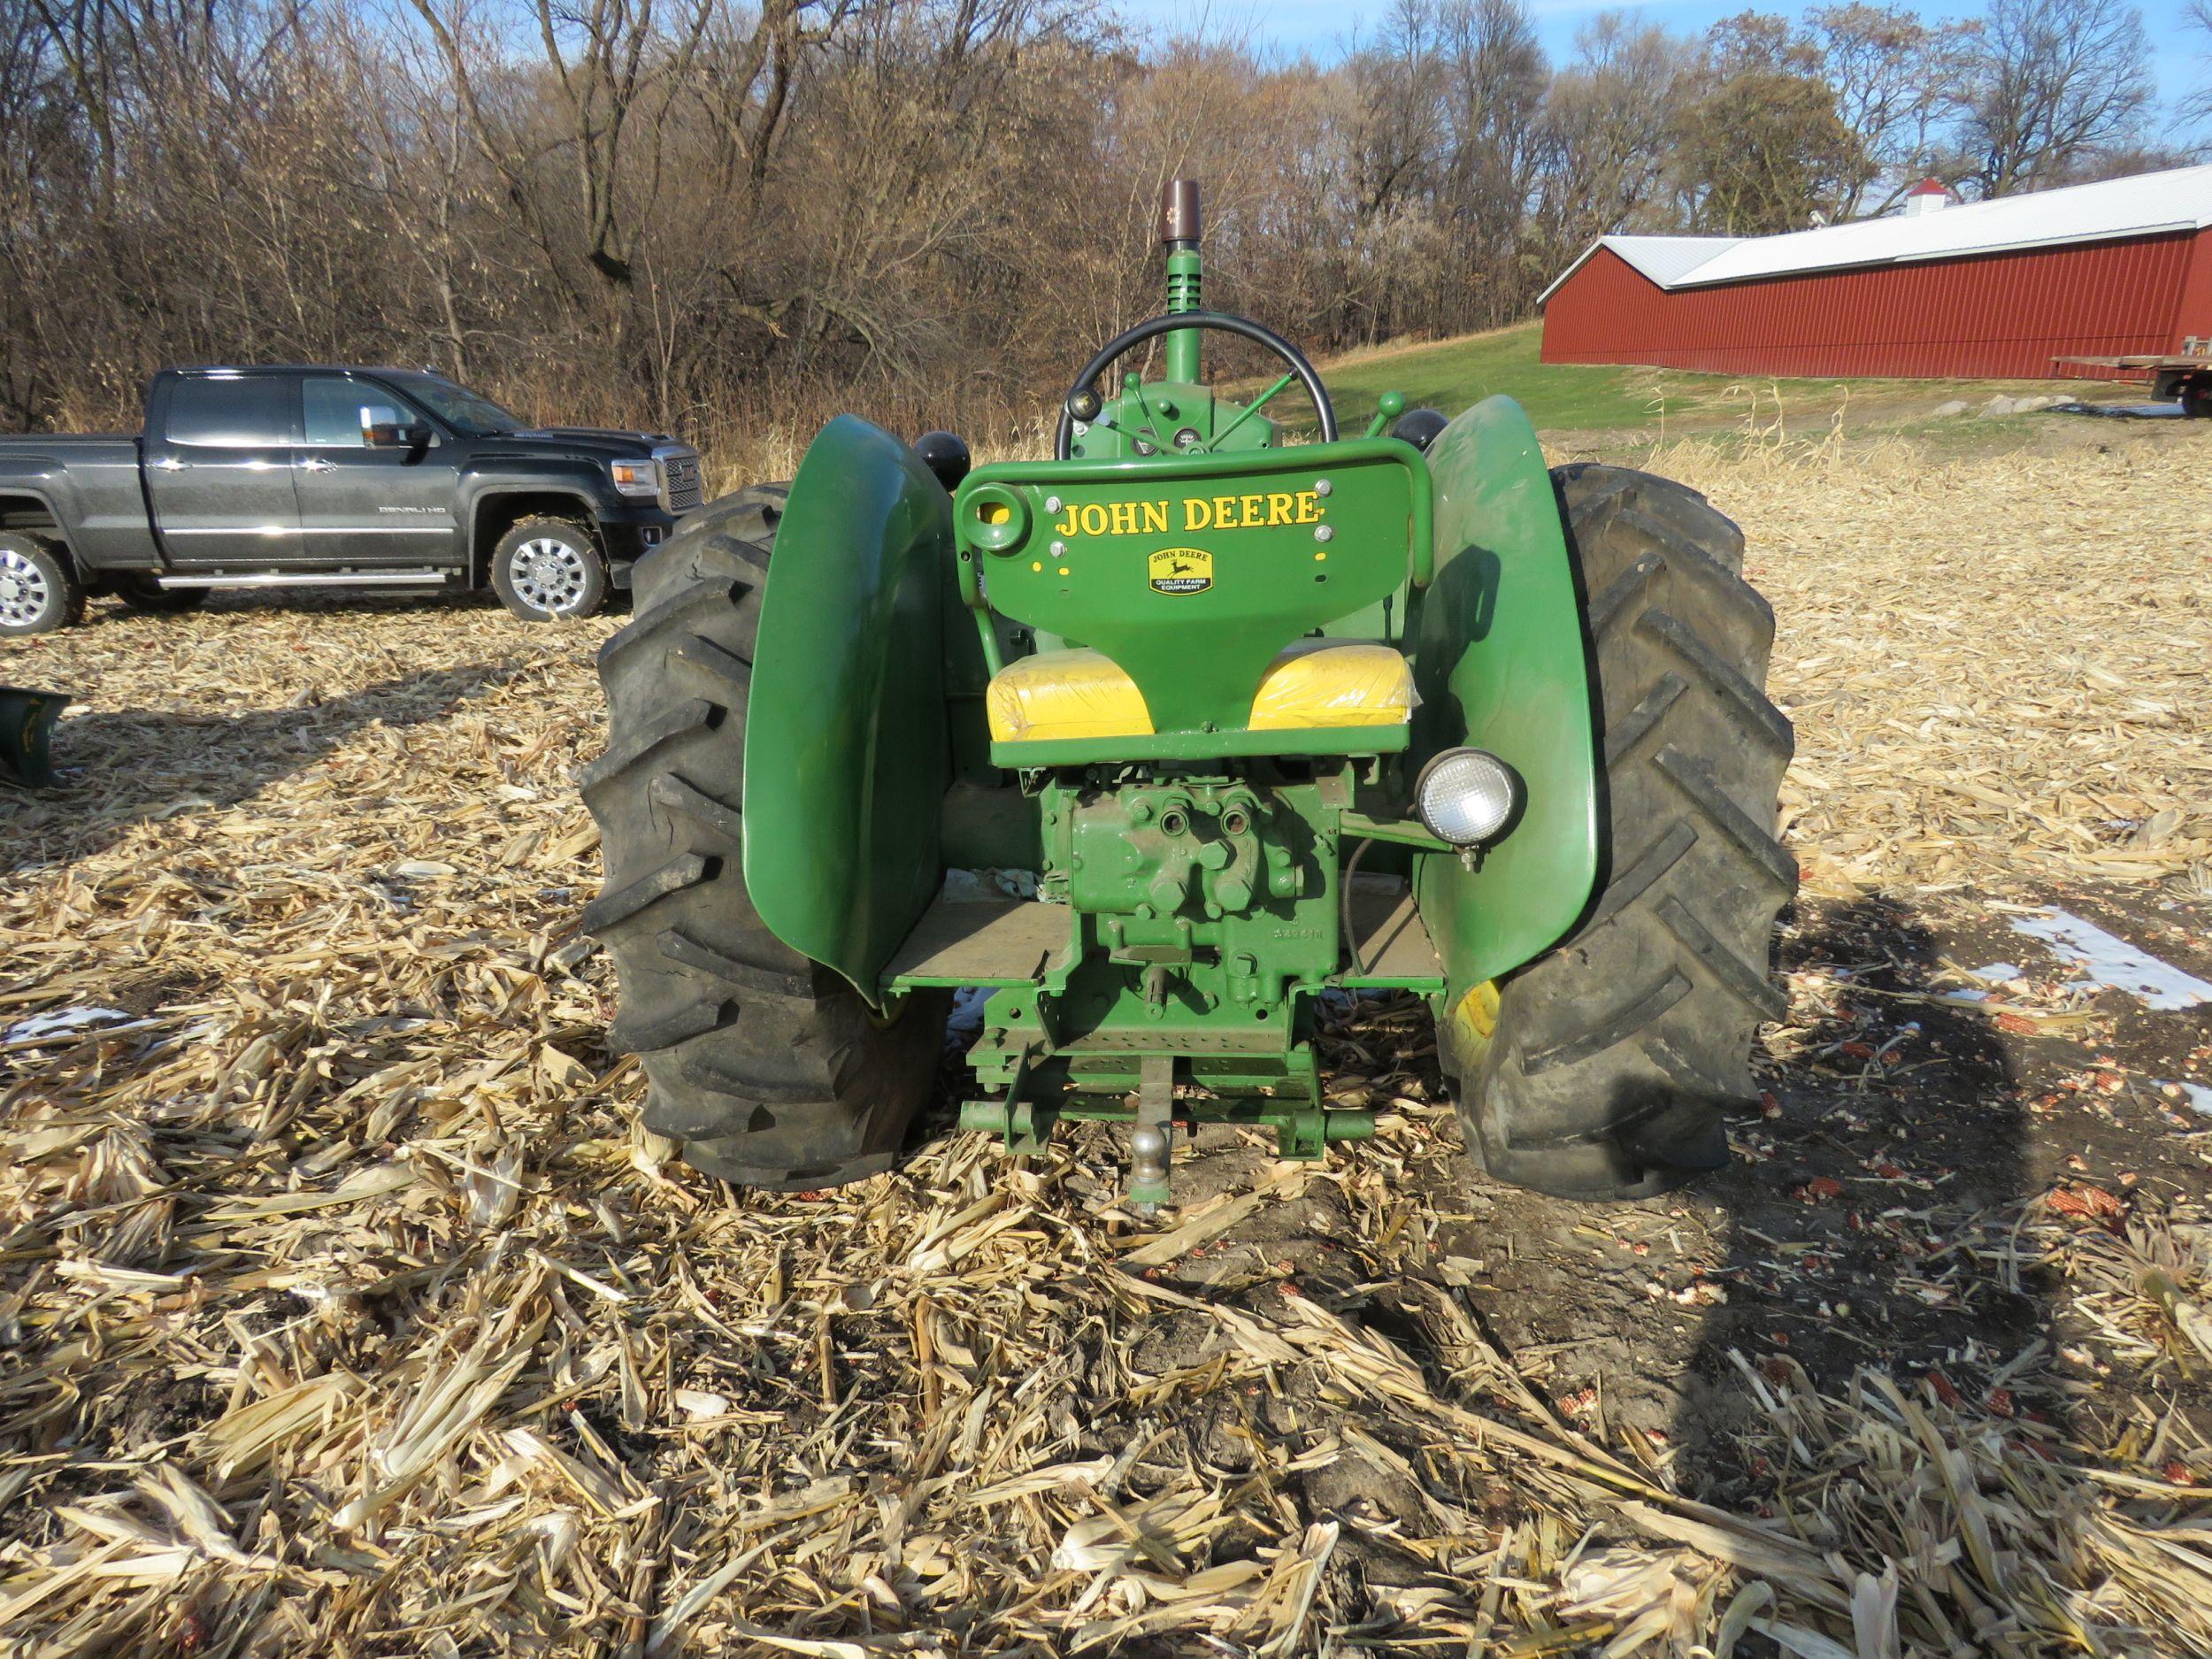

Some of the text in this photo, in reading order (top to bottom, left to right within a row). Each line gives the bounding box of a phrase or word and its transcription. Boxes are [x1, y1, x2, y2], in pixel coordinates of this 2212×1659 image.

[1060, 490, 1321, 537] JOHN DEERE
[1153, 550, 1208, 563] JOHN DEERE
